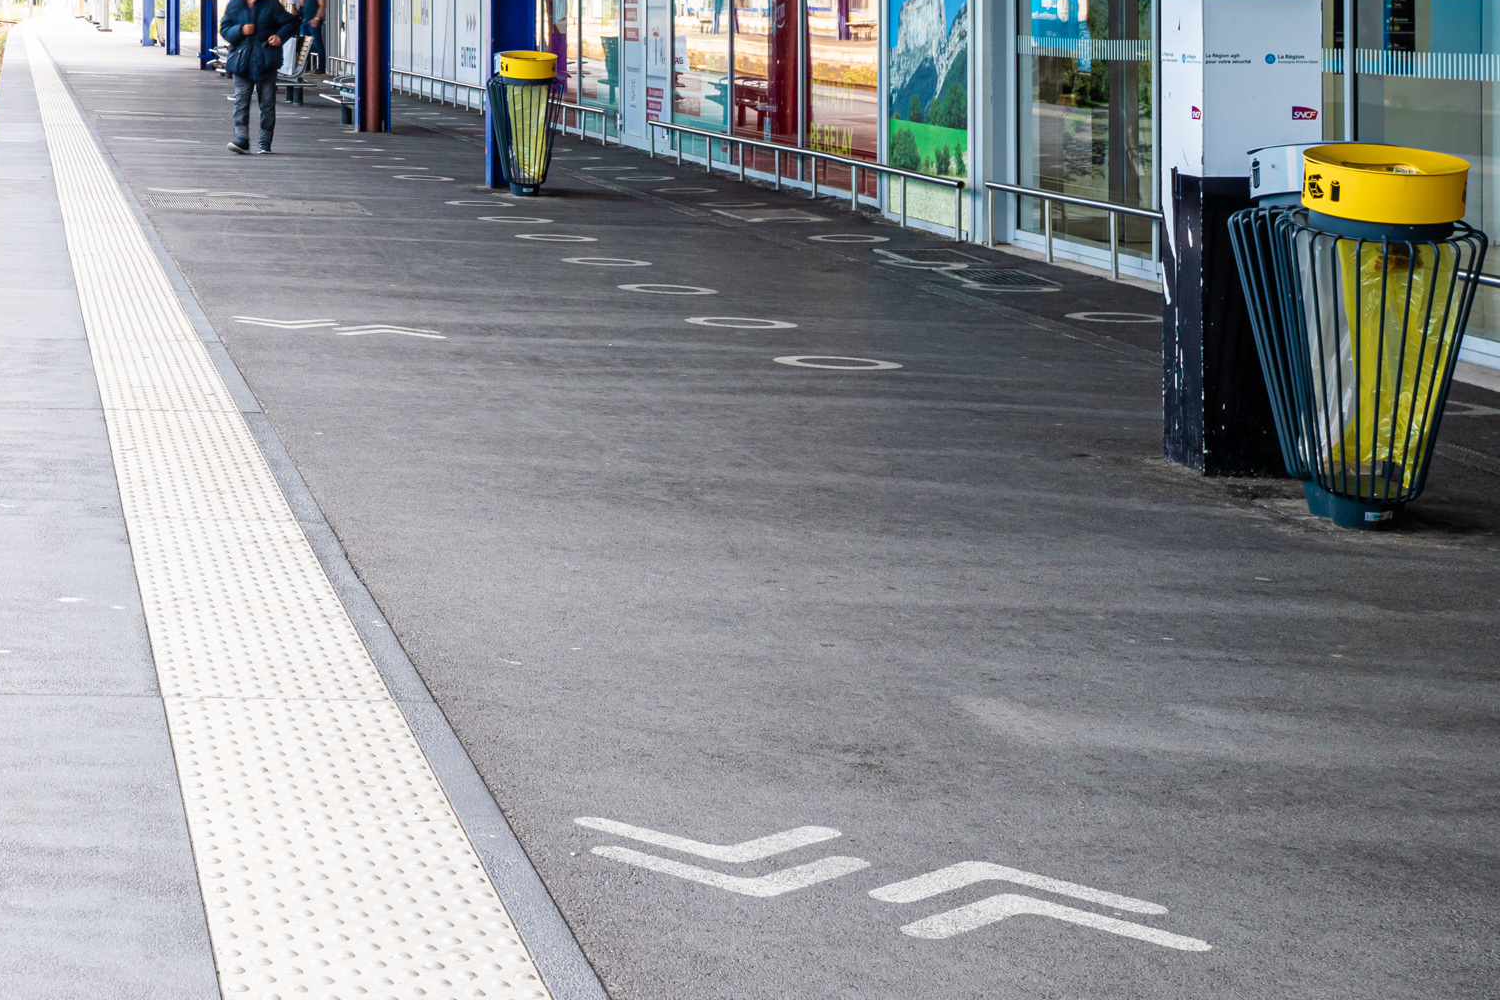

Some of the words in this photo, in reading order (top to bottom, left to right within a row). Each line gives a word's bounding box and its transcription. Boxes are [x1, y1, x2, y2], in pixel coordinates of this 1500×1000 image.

[1293, 111, 1317, 119] SNCF
[810, 122, 821, 151] BE
[824, 124, 854, 157] RELAY
